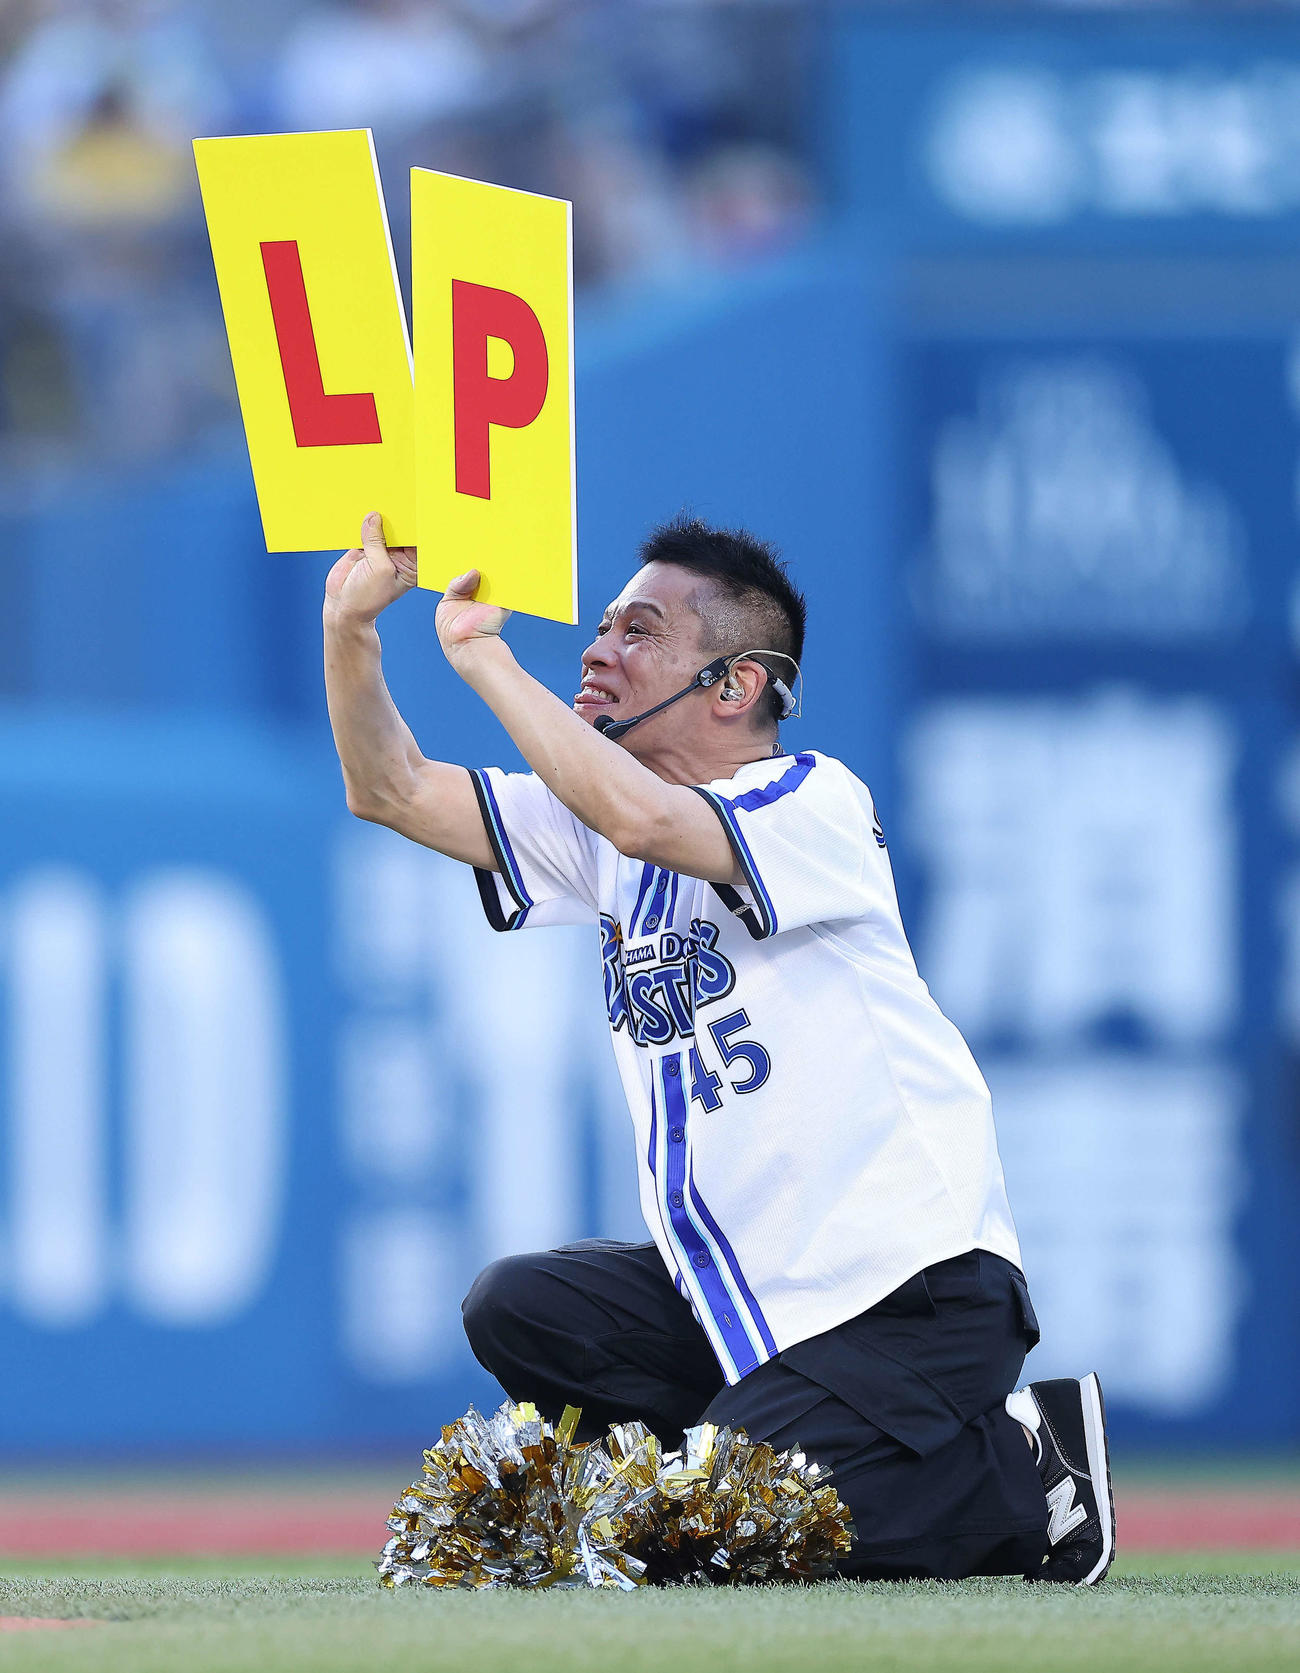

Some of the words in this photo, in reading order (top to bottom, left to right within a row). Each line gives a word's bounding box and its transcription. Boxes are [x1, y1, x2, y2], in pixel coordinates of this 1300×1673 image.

[260, 240, 382, 447] L
[452, 279, 548, 500] P
[690, 1008, 771, 1114] 45
